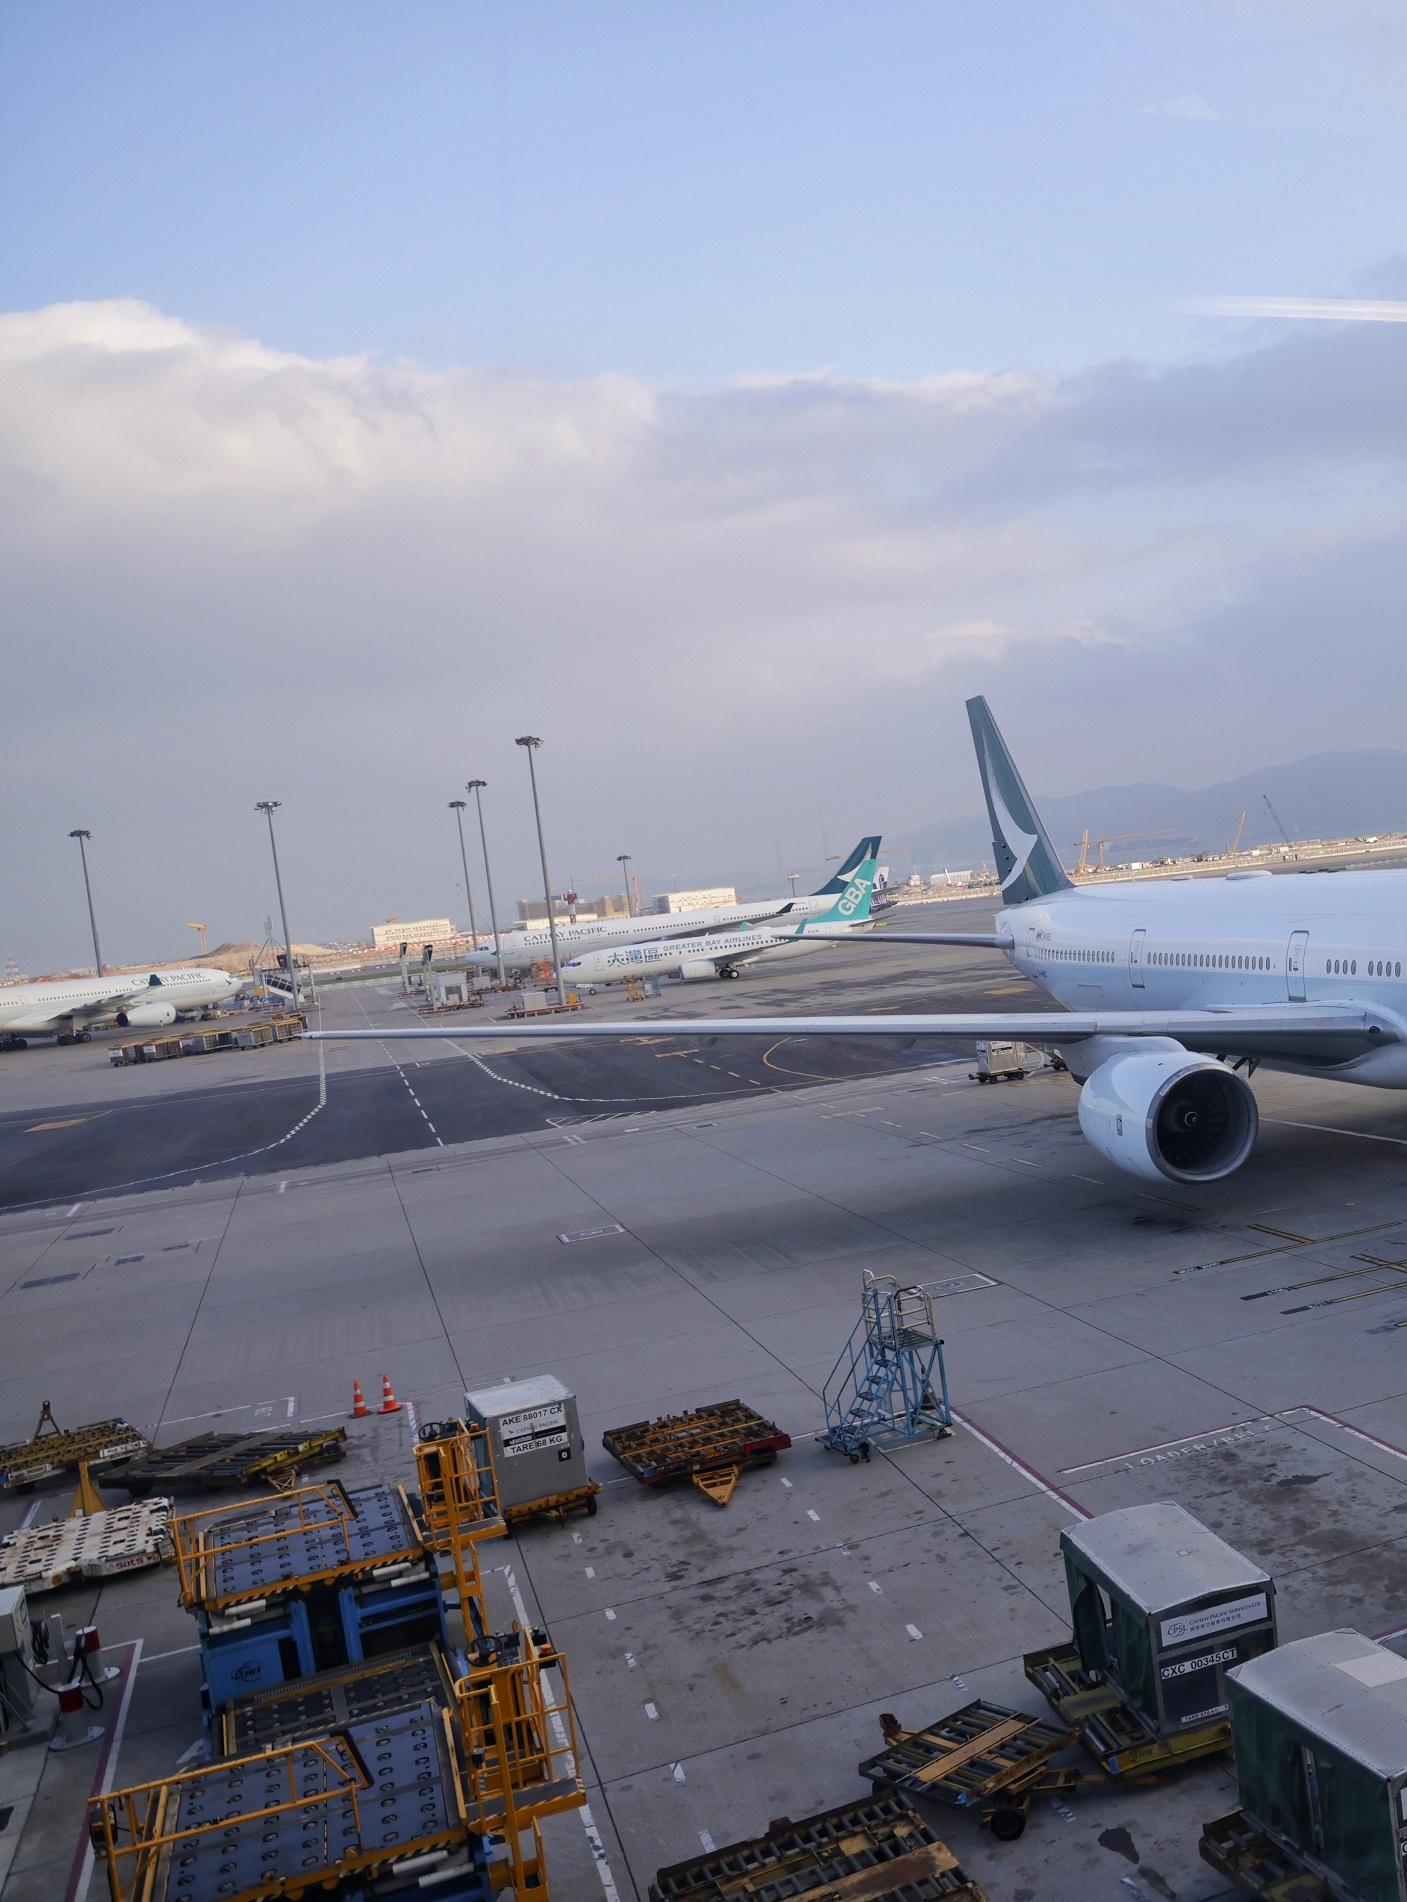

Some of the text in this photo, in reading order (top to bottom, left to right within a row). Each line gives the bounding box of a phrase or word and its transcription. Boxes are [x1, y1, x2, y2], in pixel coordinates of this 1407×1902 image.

[838, 878, 872, 916] GBA
[568, 926, 607, 937] PACIFIC
[663, 934, 763, 951] GREATER BAY AIRLINES
[607, 947, 661, 967] 大灣區
[502, 1406, 563, 1426] AKE 88017 CX
[511, 1442, 535, 1454] TARE
[549, 1435, 563, 1444] KG
[1189, 1616, 1209, 1626] CATHAY
[1167, 1623, 1187, 1637] CPSL
[1161, 1664, 1186, 1678] CXC
